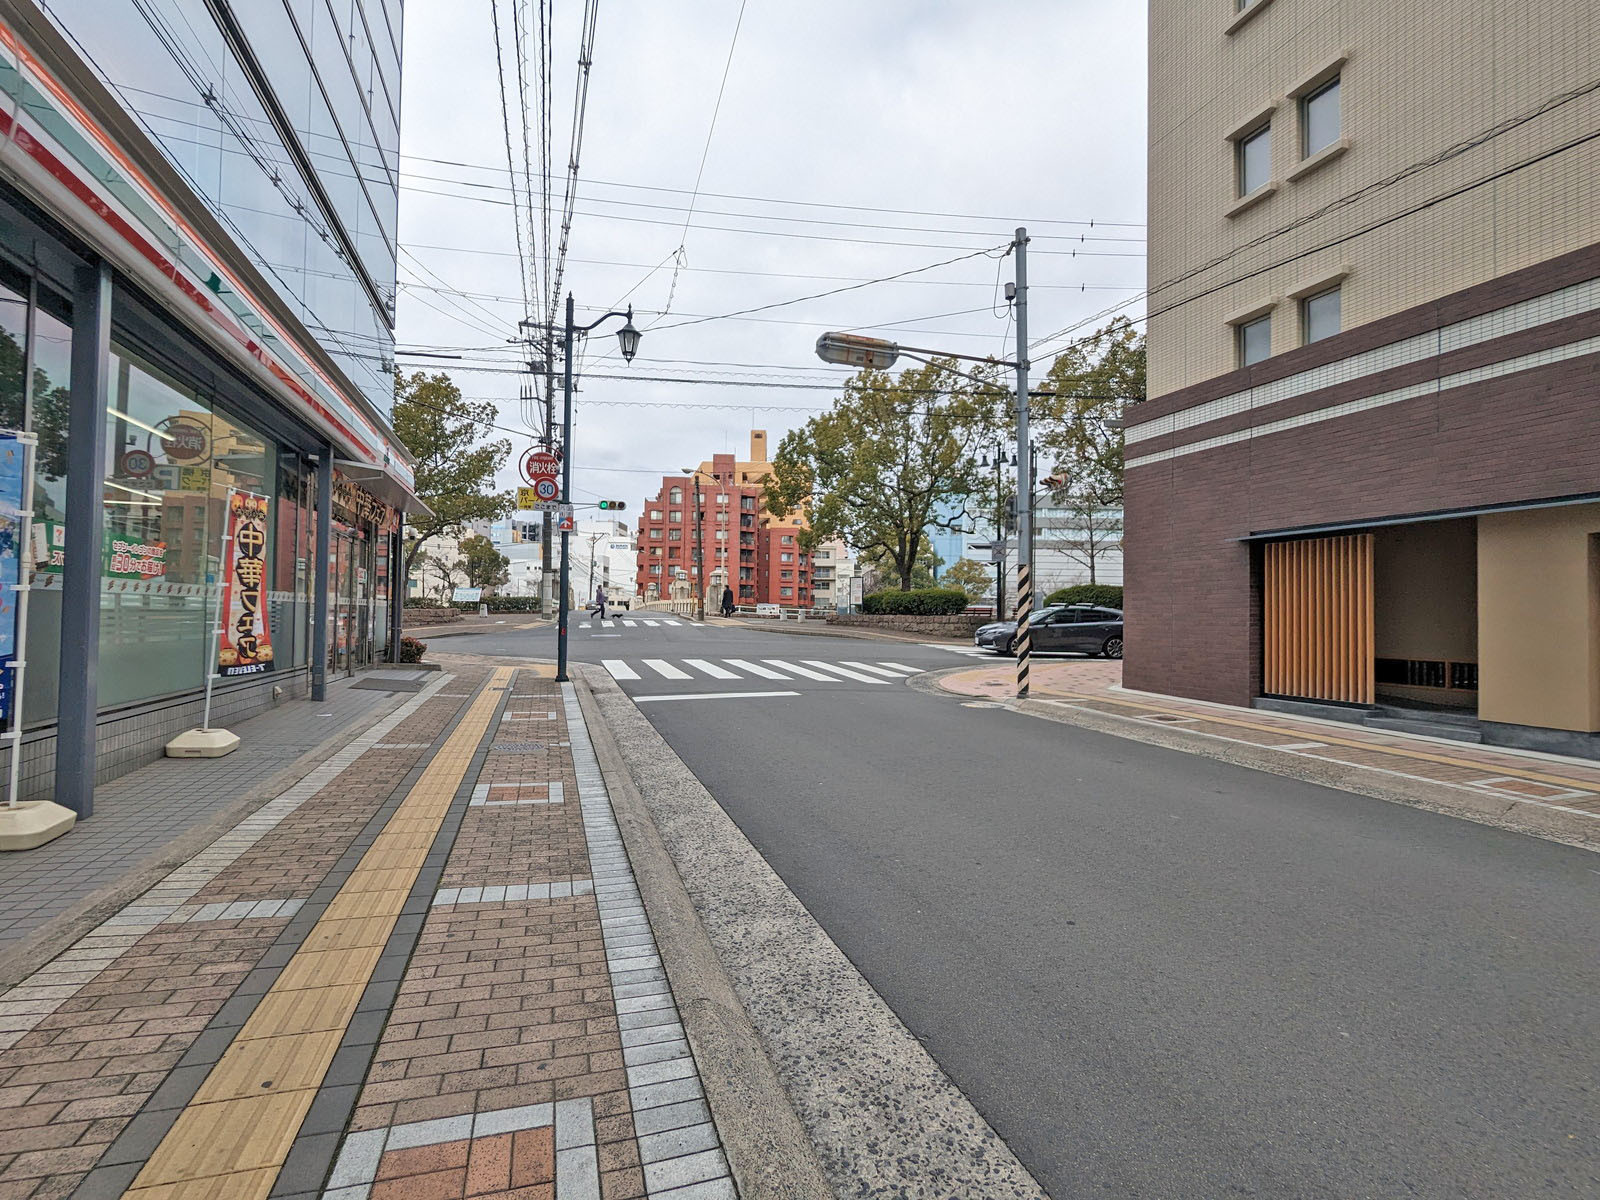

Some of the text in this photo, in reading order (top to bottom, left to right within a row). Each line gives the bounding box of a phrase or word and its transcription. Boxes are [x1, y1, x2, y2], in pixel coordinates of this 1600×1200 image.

[529, 461, 558, 474] 消火栓
[539, 483, 554, 495] 30
